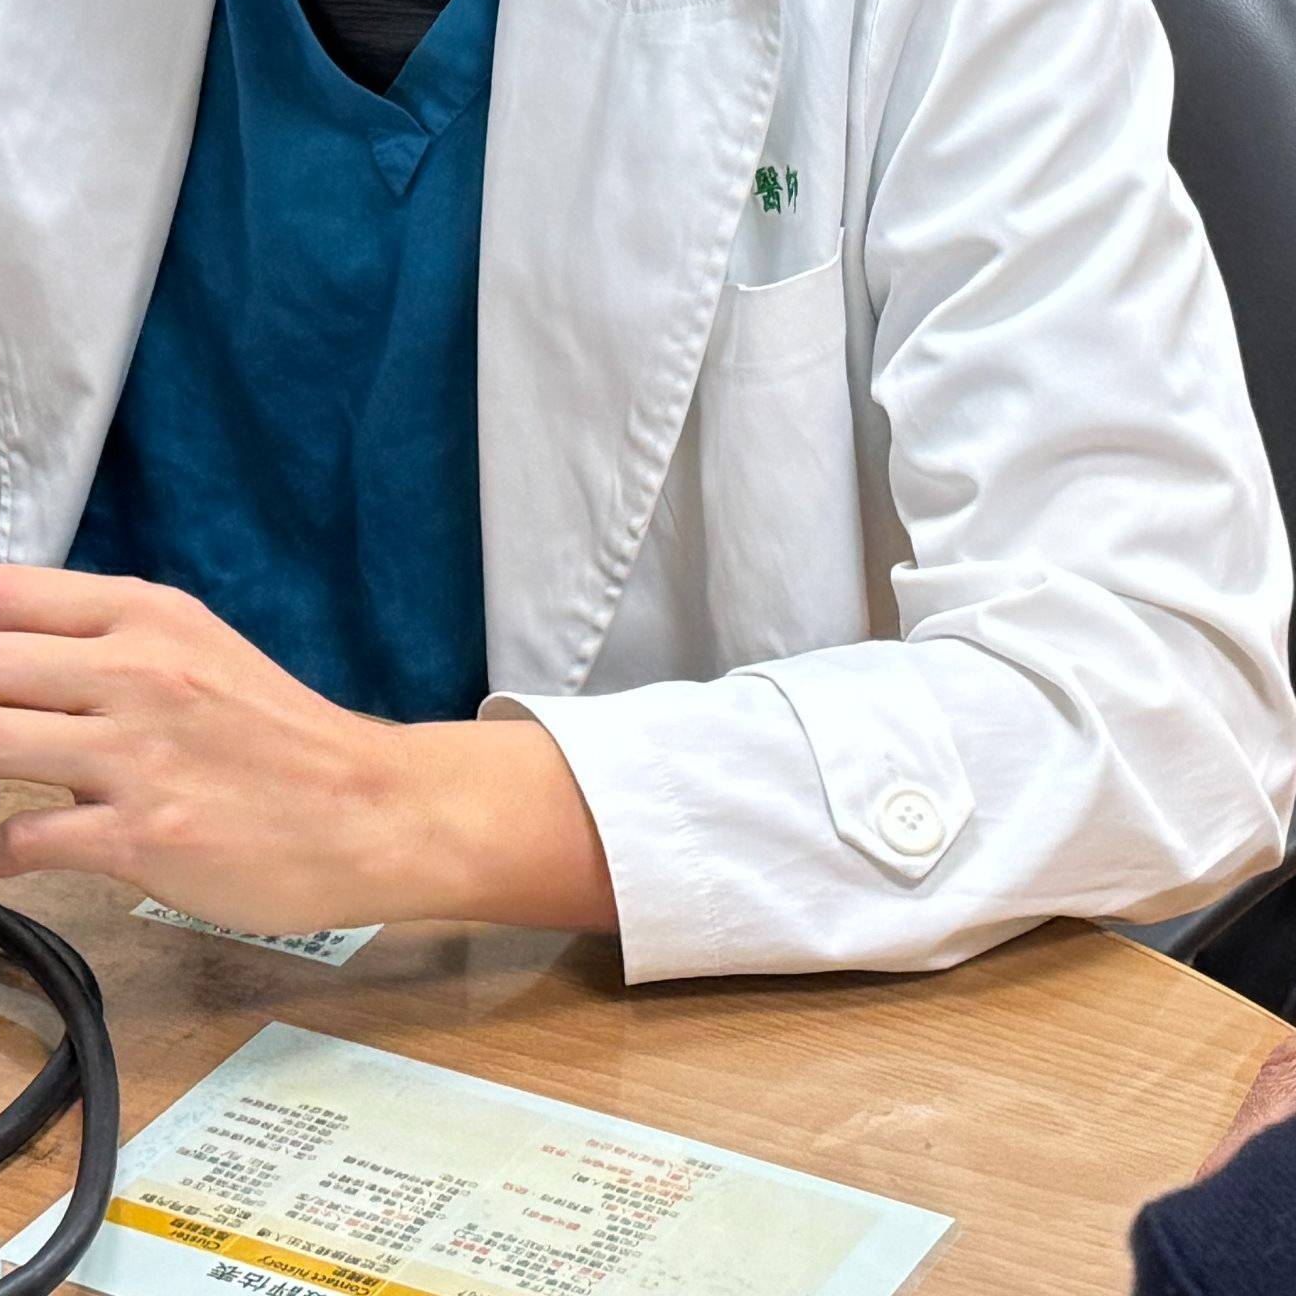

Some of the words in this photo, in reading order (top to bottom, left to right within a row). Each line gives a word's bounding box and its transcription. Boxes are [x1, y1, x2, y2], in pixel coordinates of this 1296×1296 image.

[168, 1231, 220, 1251] Cluster
[257, 1256, 310, 1280] history
[311, 1272, 371, 1296] Contact
